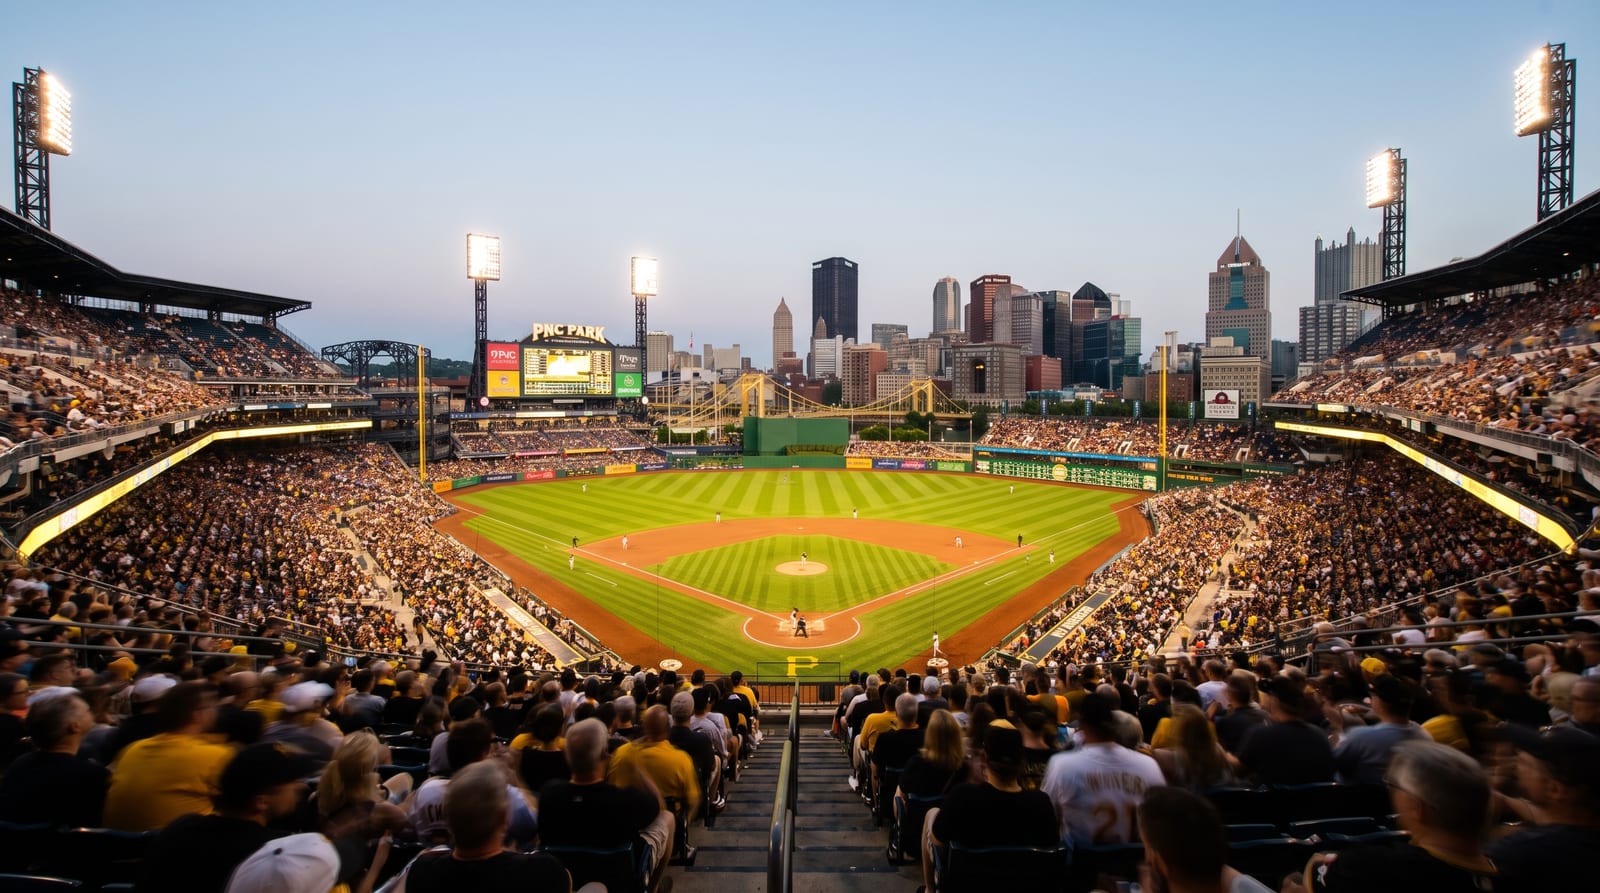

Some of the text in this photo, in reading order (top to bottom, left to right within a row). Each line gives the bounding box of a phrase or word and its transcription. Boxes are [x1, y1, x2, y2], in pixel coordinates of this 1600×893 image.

[531, 322, 607, 345] PNC PARK
[499, 350, 516, 360] PNC
[786, 655, 819, 679] P
